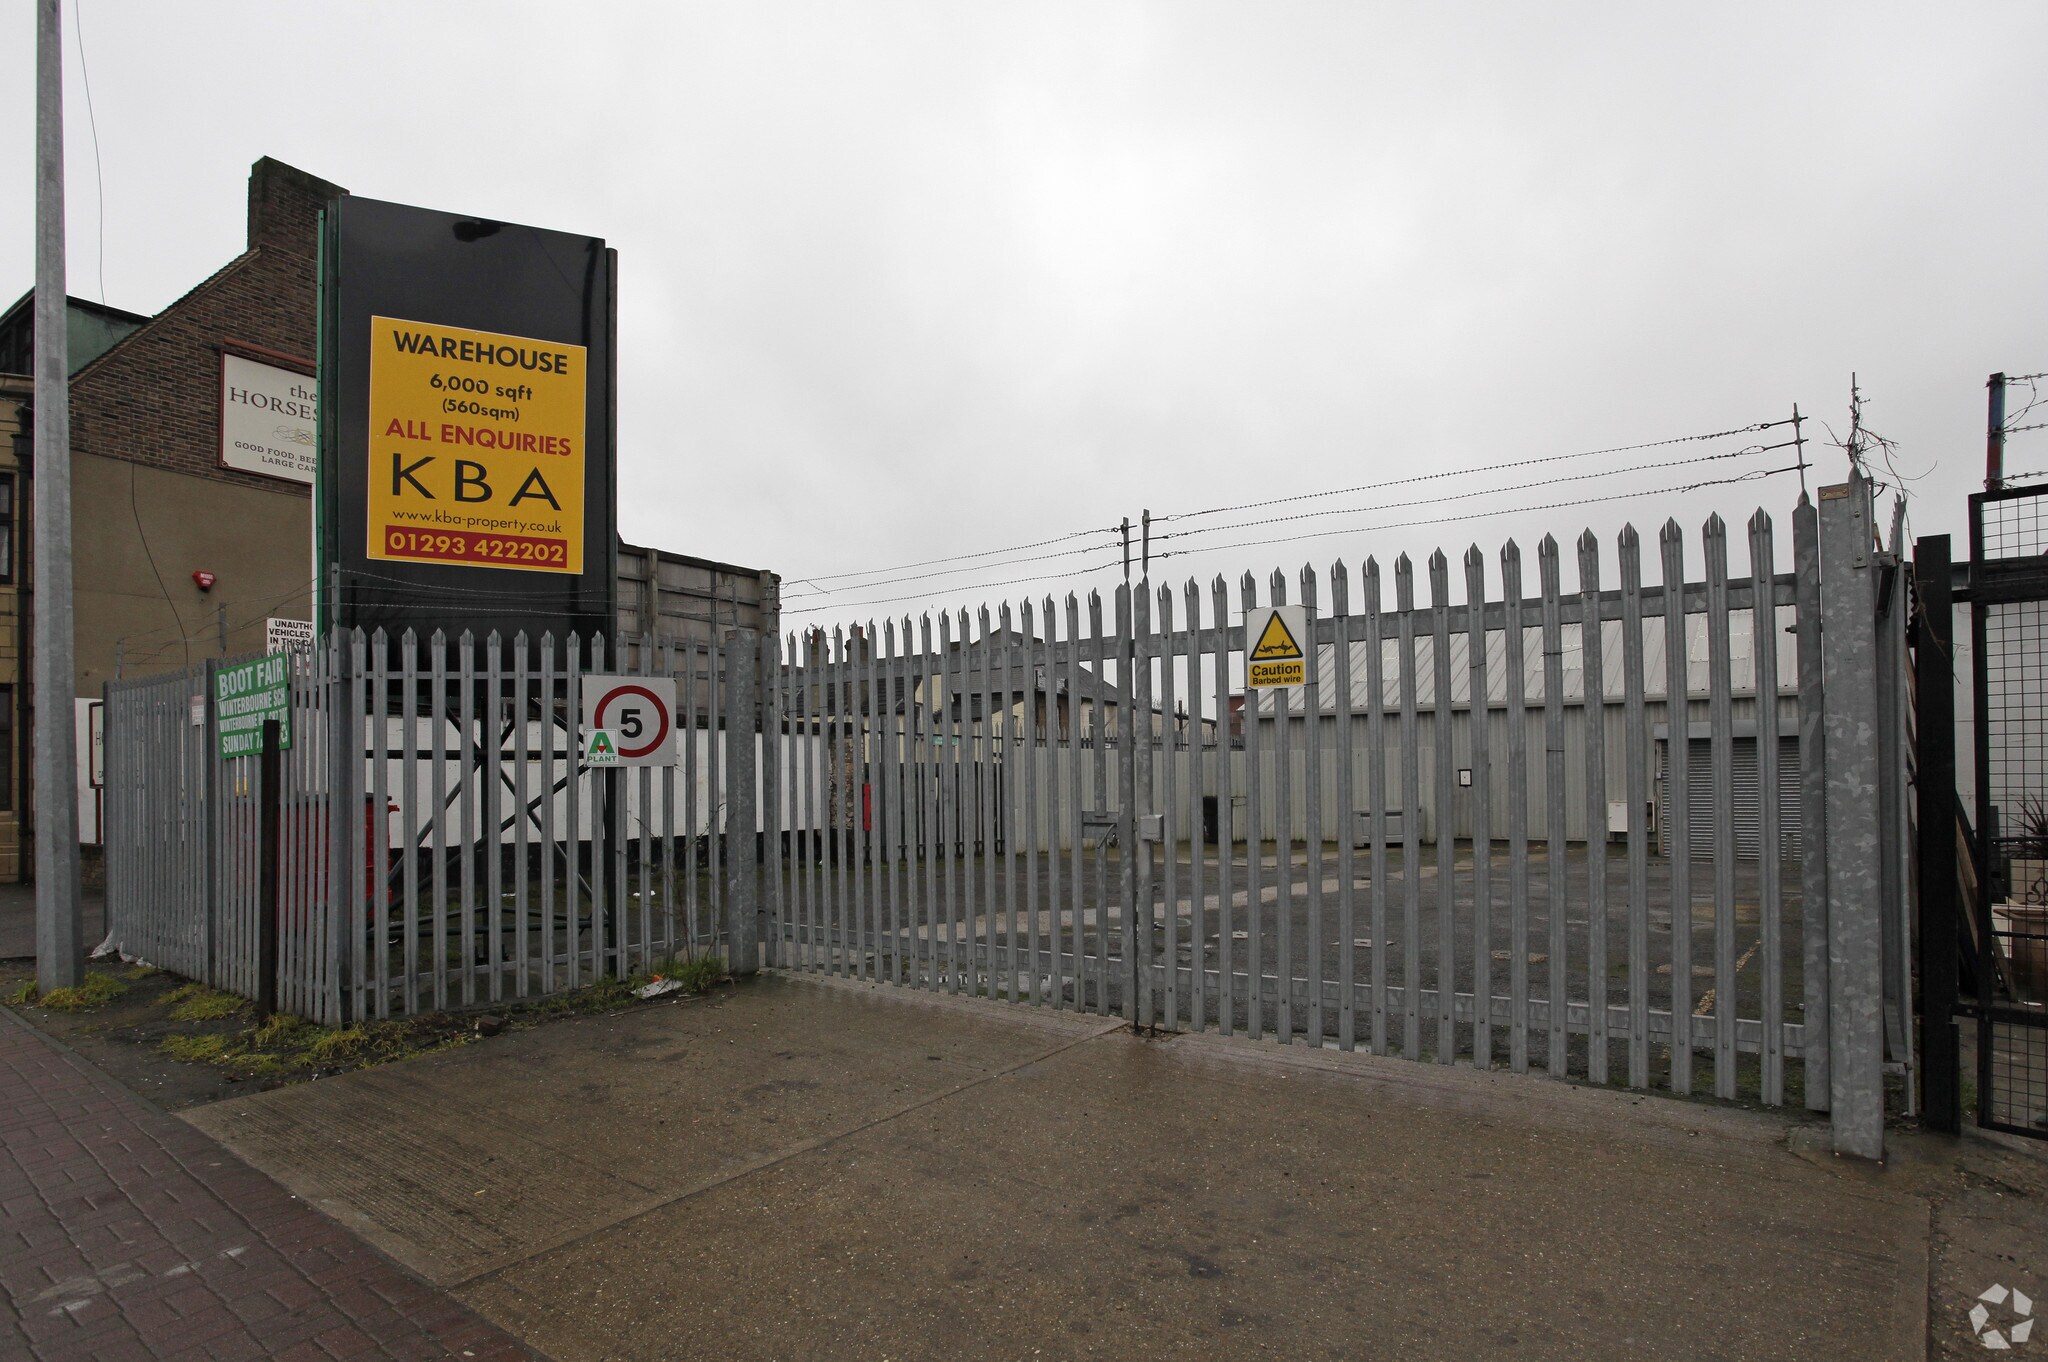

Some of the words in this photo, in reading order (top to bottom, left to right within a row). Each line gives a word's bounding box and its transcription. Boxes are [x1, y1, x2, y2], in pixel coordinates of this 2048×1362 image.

[393, 330, 568, 374] WAREHOUSE
[290, 385, 317, 402] the
[430, 374, 489, 394] 6,000
[496, 384, 532, 402] sqft
[442, 398, 519, 422] (560sqm)
[235, 441, 264, 452] GOOD
[386, 418, 431, 440] ALL
[441, 424, 571, 456] ENQUIRIES
[262, 456, 294, 468] LARGE
[392, 509, 562, 533] www.kba-property.co.uk
[389, 532, 466, 554] 01293
[473, 539, 564, 562] 422202
[269, 628, 310, 638] VEHICLES
[219, 666, 253, 696] BOOT
[257, 658, 283, 687] FAIR
[1252, 664, 1300, 676] Caution
[1253, 676, 1281, 684] Barbed
[219, 692, 272, 716] WINTERBOURNE
[620, 709, 642, 738] 5
[223, 732, 253, 753] SUNDAY
[589, 732, 614, 754] A
